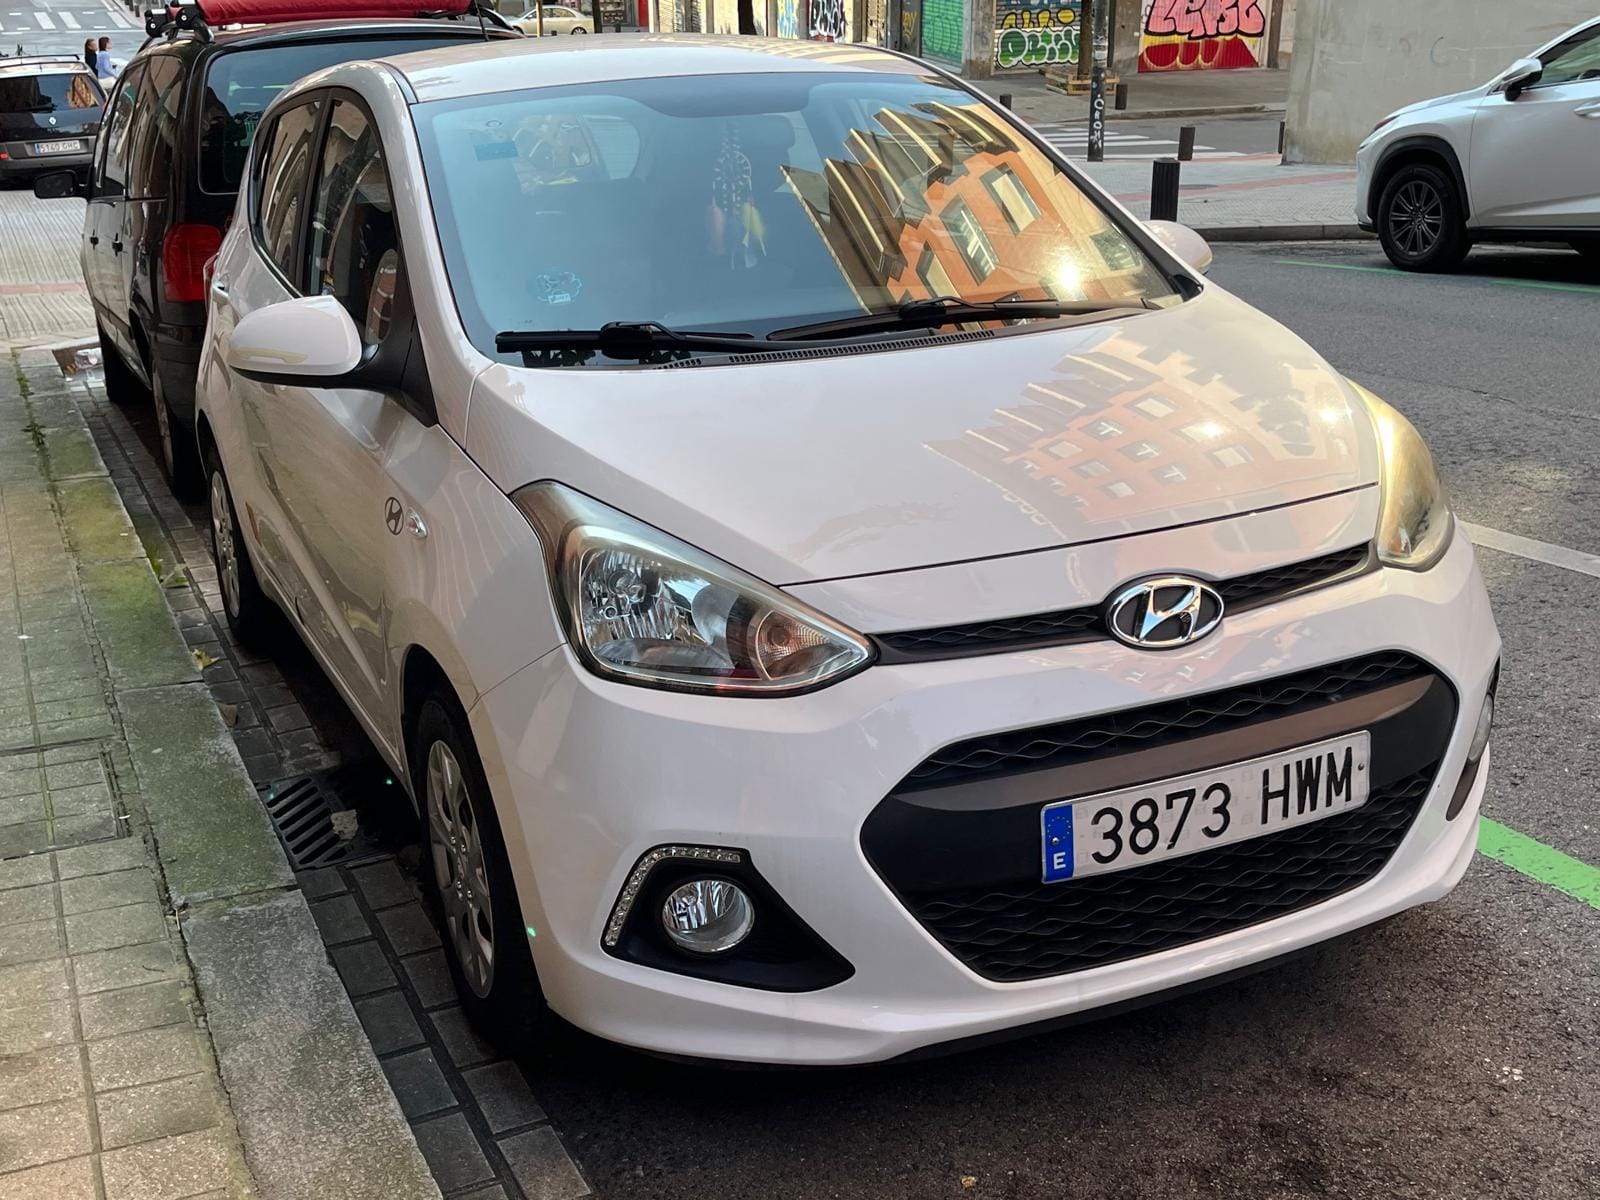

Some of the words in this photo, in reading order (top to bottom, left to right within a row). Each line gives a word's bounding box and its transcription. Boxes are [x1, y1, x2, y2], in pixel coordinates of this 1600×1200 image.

[1053, 851, 1066, 871] E
[1091, 782, 1232, 865] 3873
[1260, 746, 1353, 826] HWM
